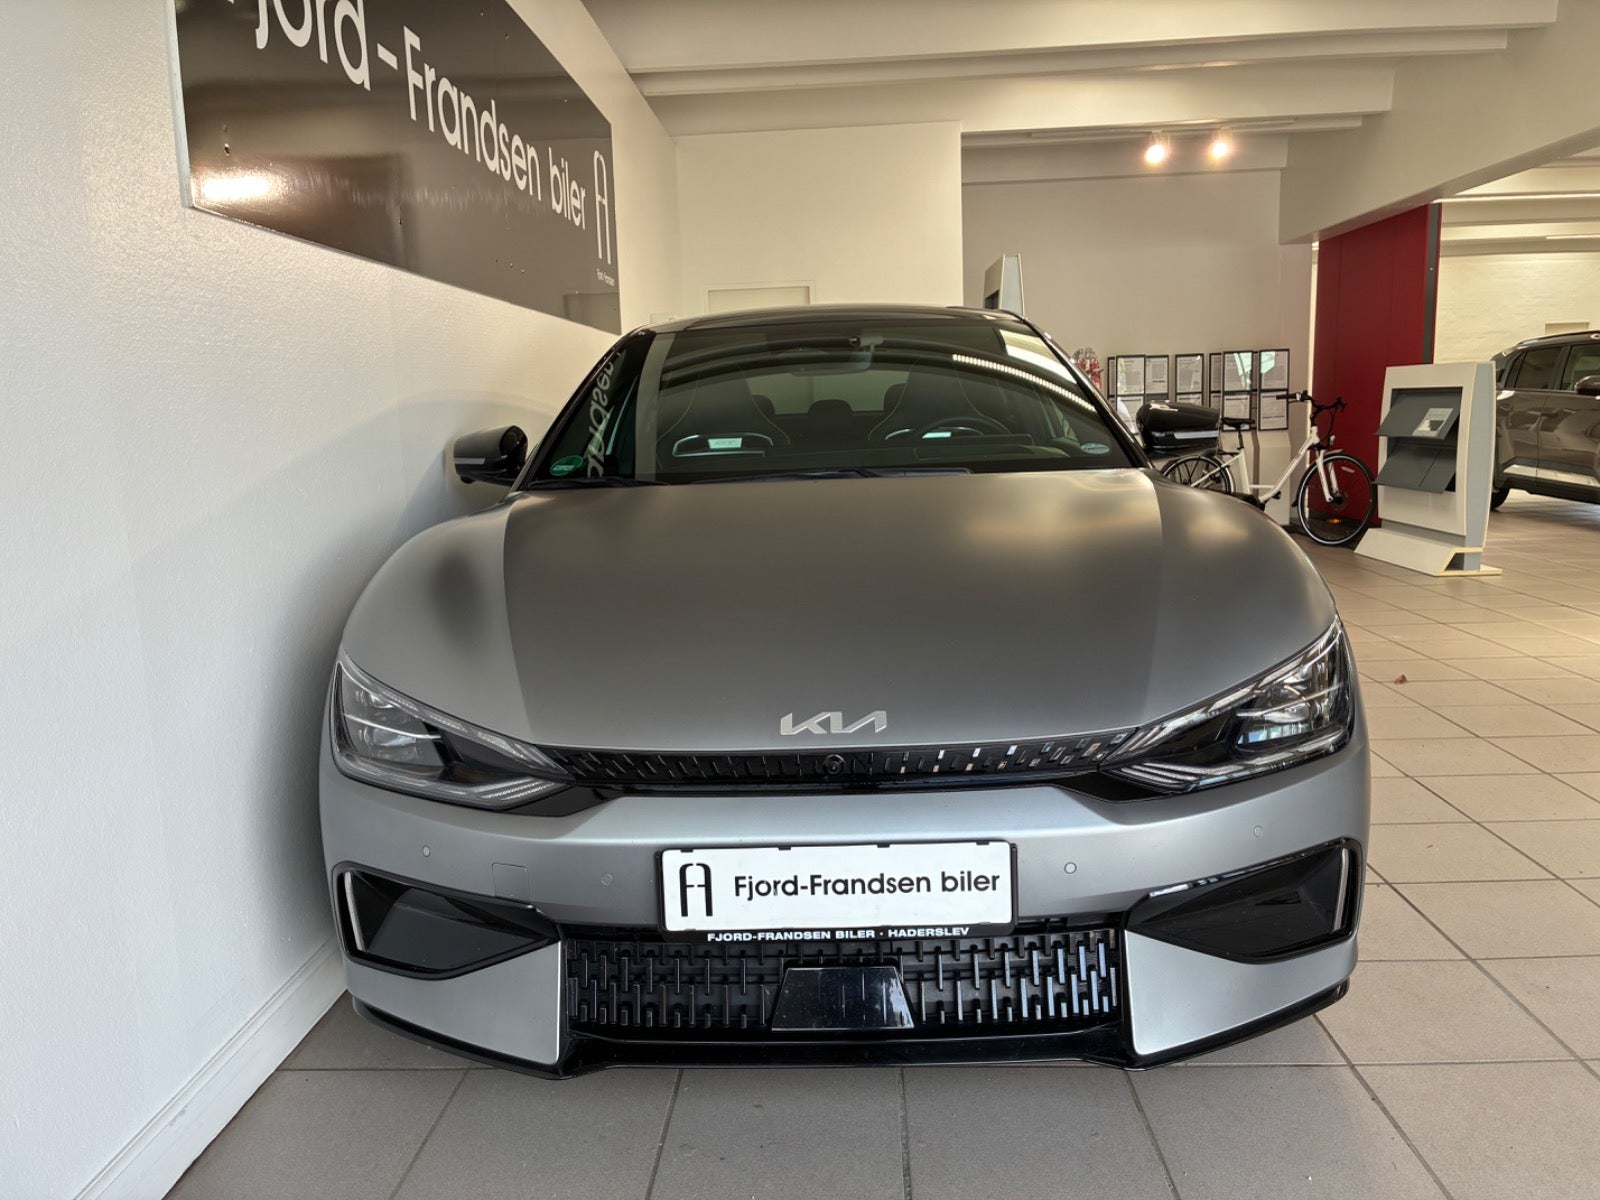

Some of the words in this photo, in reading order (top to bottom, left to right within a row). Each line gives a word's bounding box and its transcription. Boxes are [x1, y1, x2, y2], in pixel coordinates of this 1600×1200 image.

[549, 147, 586, 230] biler
[734, 873, 931, 901] Fjord-Frandsen
[941, 871, 1000, 893] biler
[707, 930, 831, 942] FJORD-FRANDSEN
[835, 929, 875, 940] BILER
[888, 927, 970, 938] HADERSLEV
